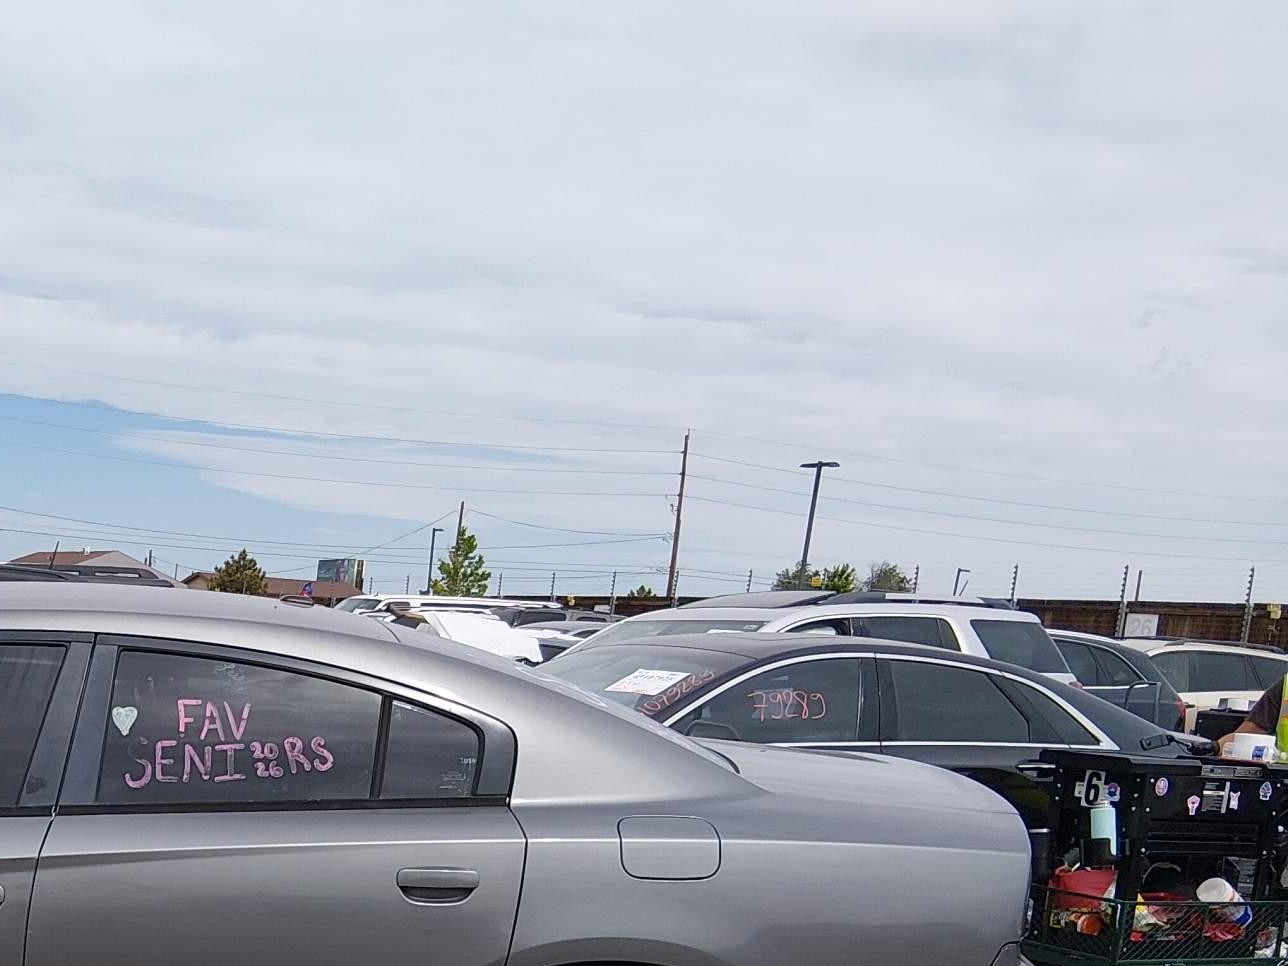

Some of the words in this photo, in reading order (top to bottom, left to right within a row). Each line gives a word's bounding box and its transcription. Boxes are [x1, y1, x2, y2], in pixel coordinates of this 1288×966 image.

[177, 699, 251, 741] FAV
[746, 689, 826, 722] 79289
[1085, 771, 1101, 805] 6
